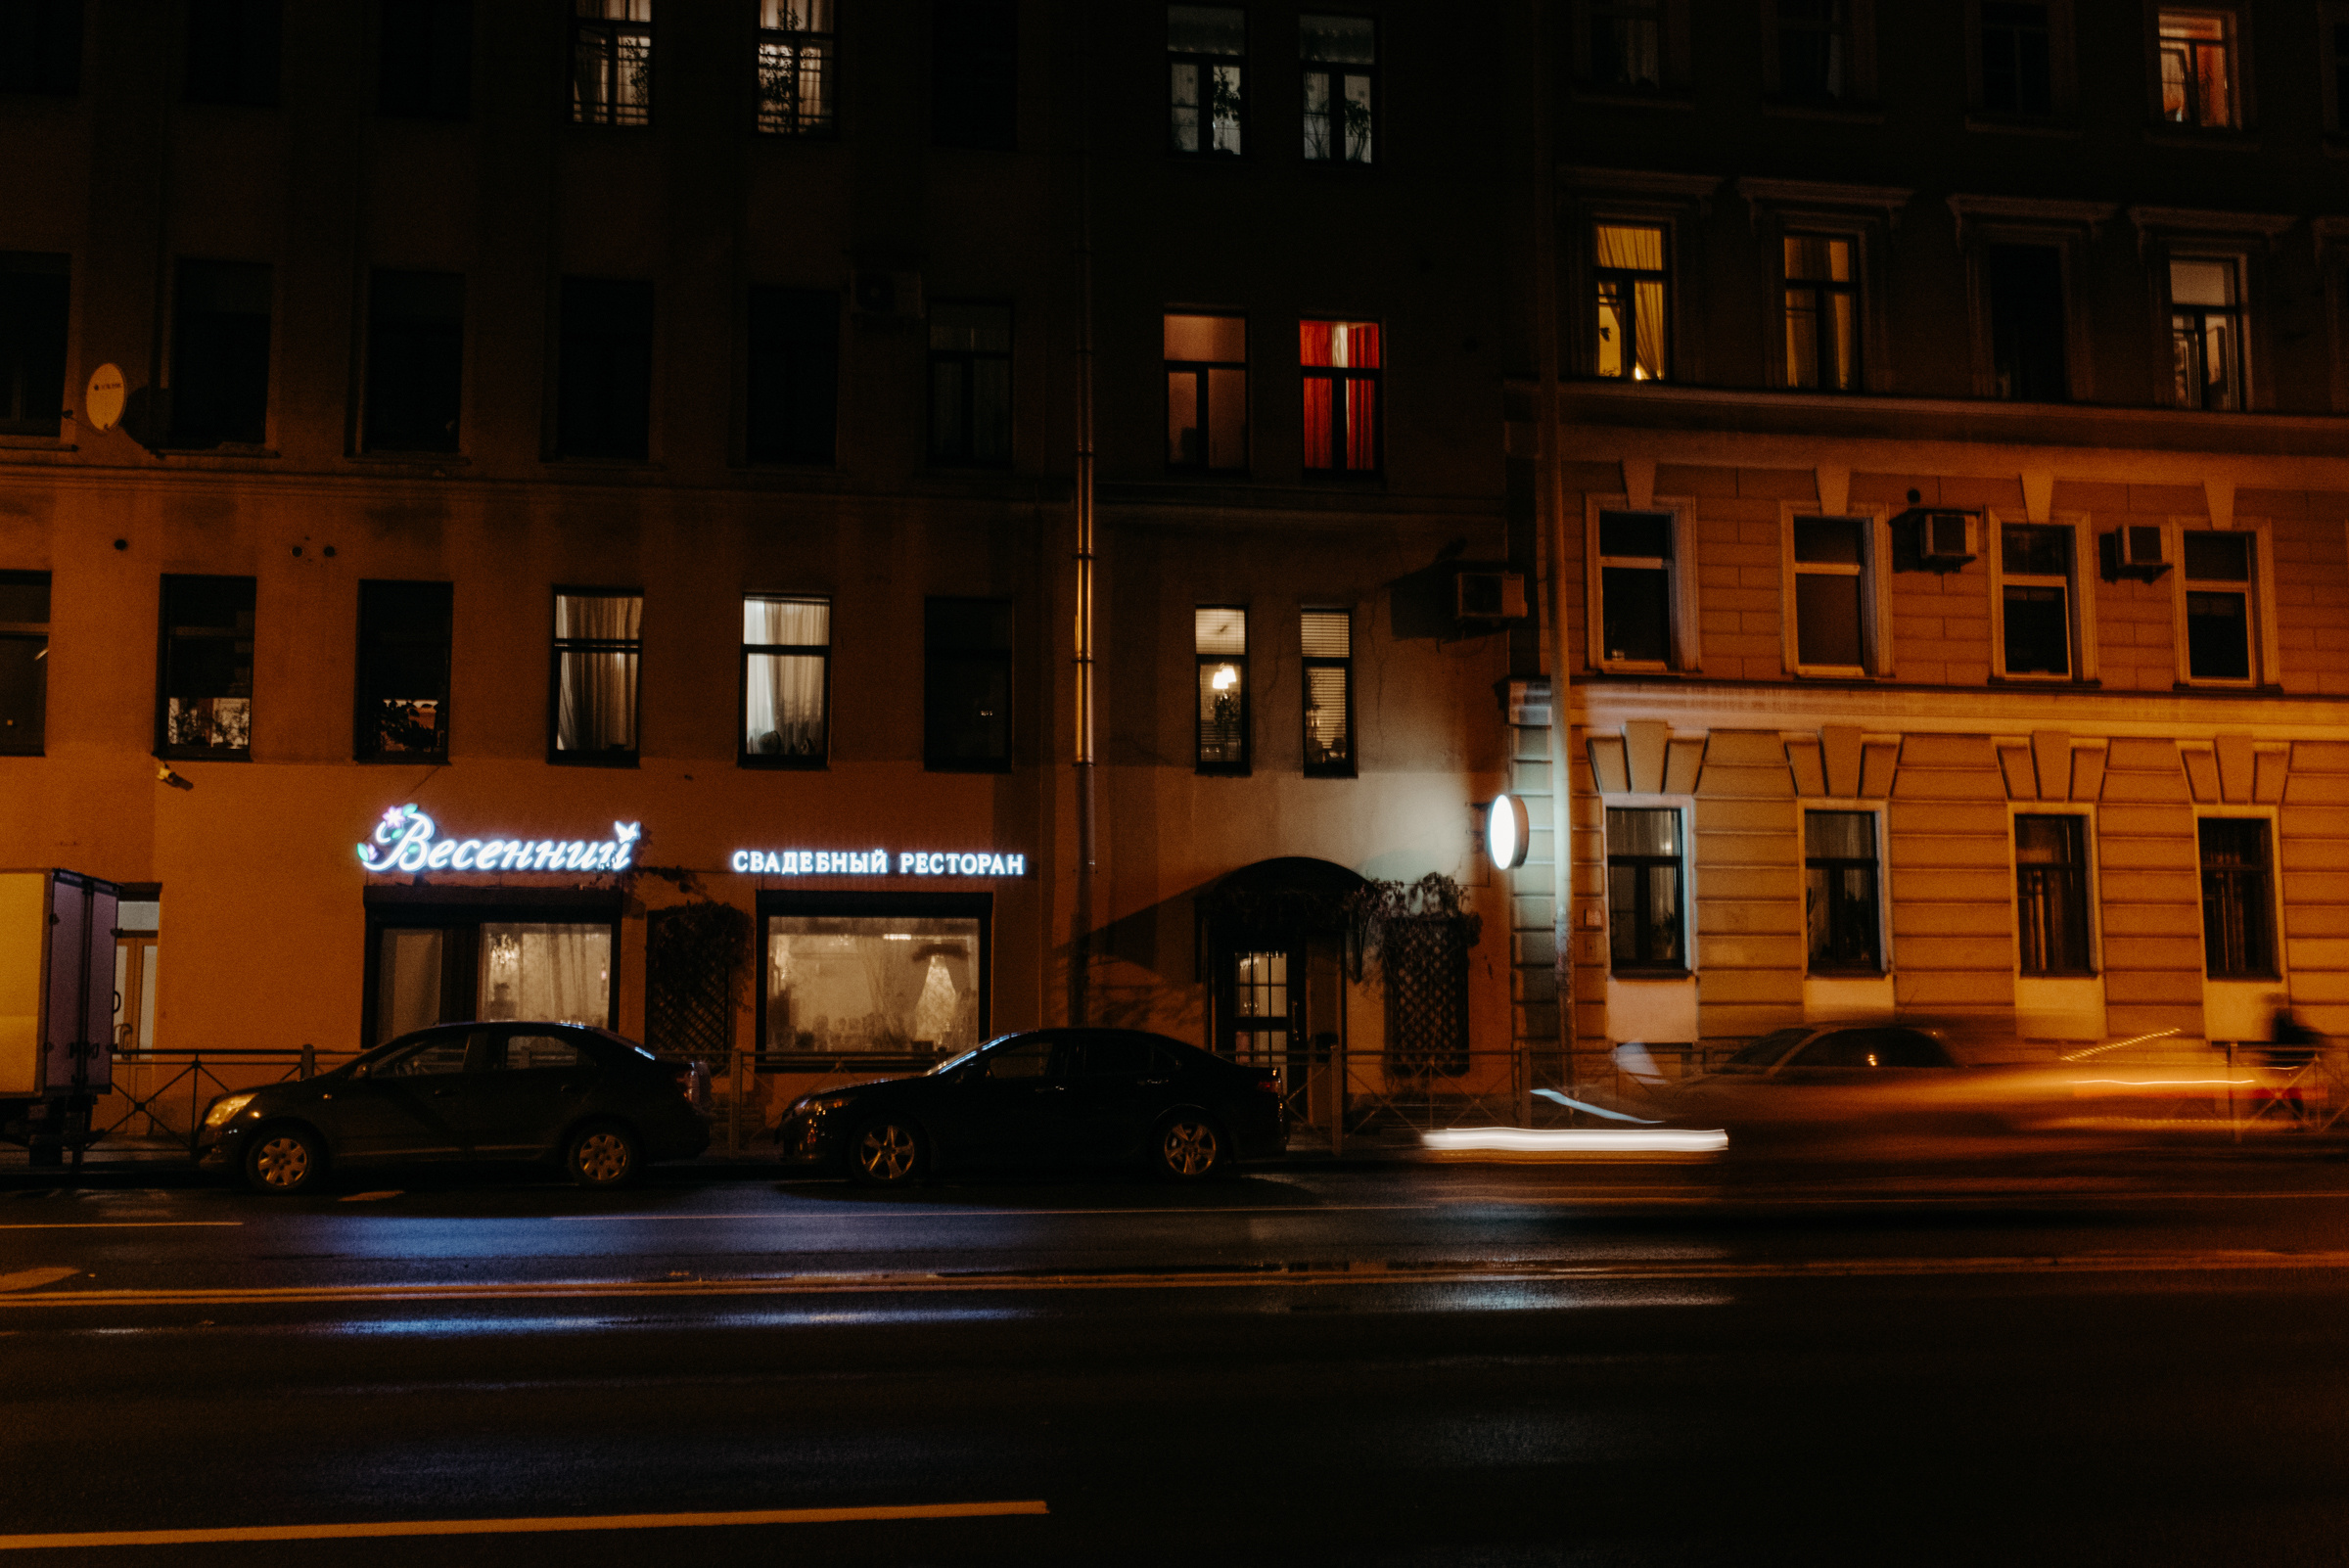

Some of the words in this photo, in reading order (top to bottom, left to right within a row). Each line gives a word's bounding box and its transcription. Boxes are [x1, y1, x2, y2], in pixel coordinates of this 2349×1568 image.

[363, 811, 640, 871] Весенний
[732, 849, 888, 875] СВАДЕБНЫЙ
[899, 853, 1025, 875] РЕСТОРАН
